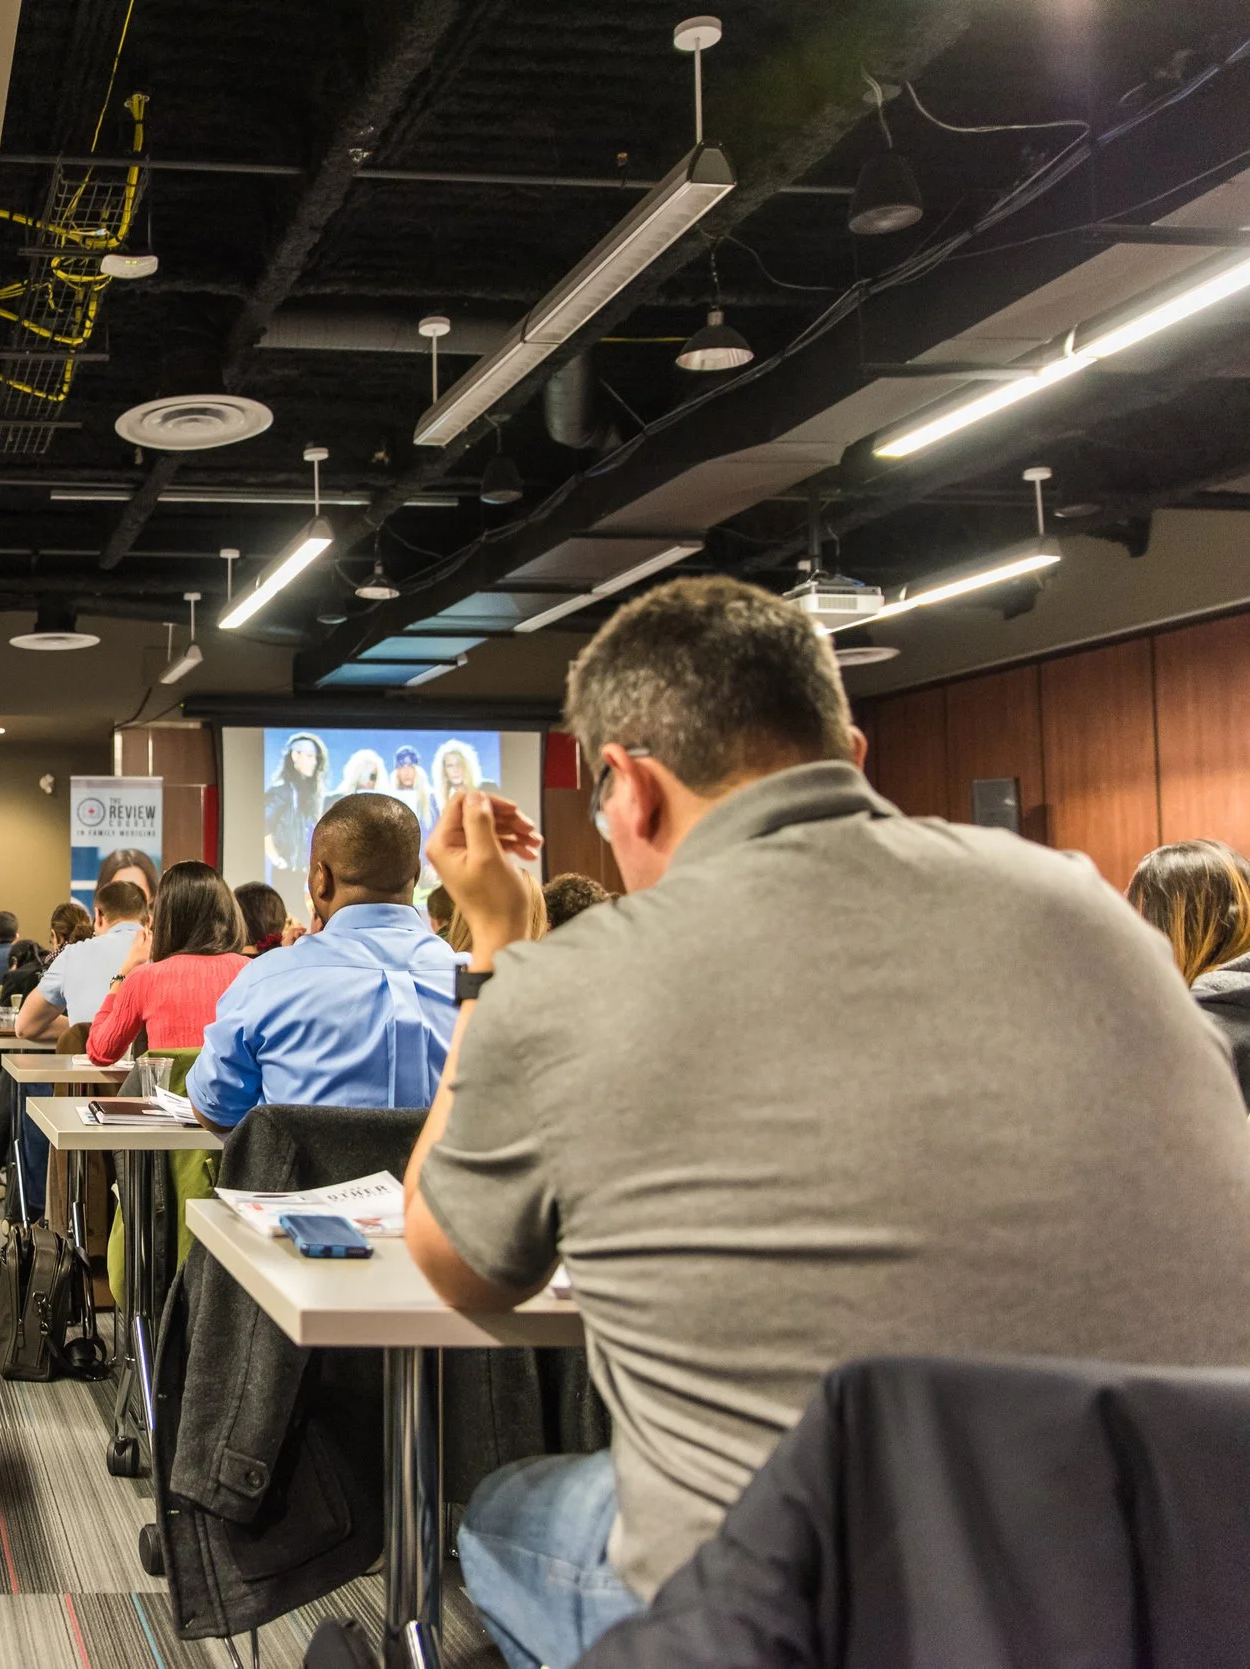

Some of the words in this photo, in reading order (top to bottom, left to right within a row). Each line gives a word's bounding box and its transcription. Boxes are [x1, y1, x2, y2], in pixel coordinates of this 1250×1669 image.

[110, 805, 156, 820] REVIEW
[109, 820, 155, 828] COURSE
[327, 1184, 388, 1200] OTHER
